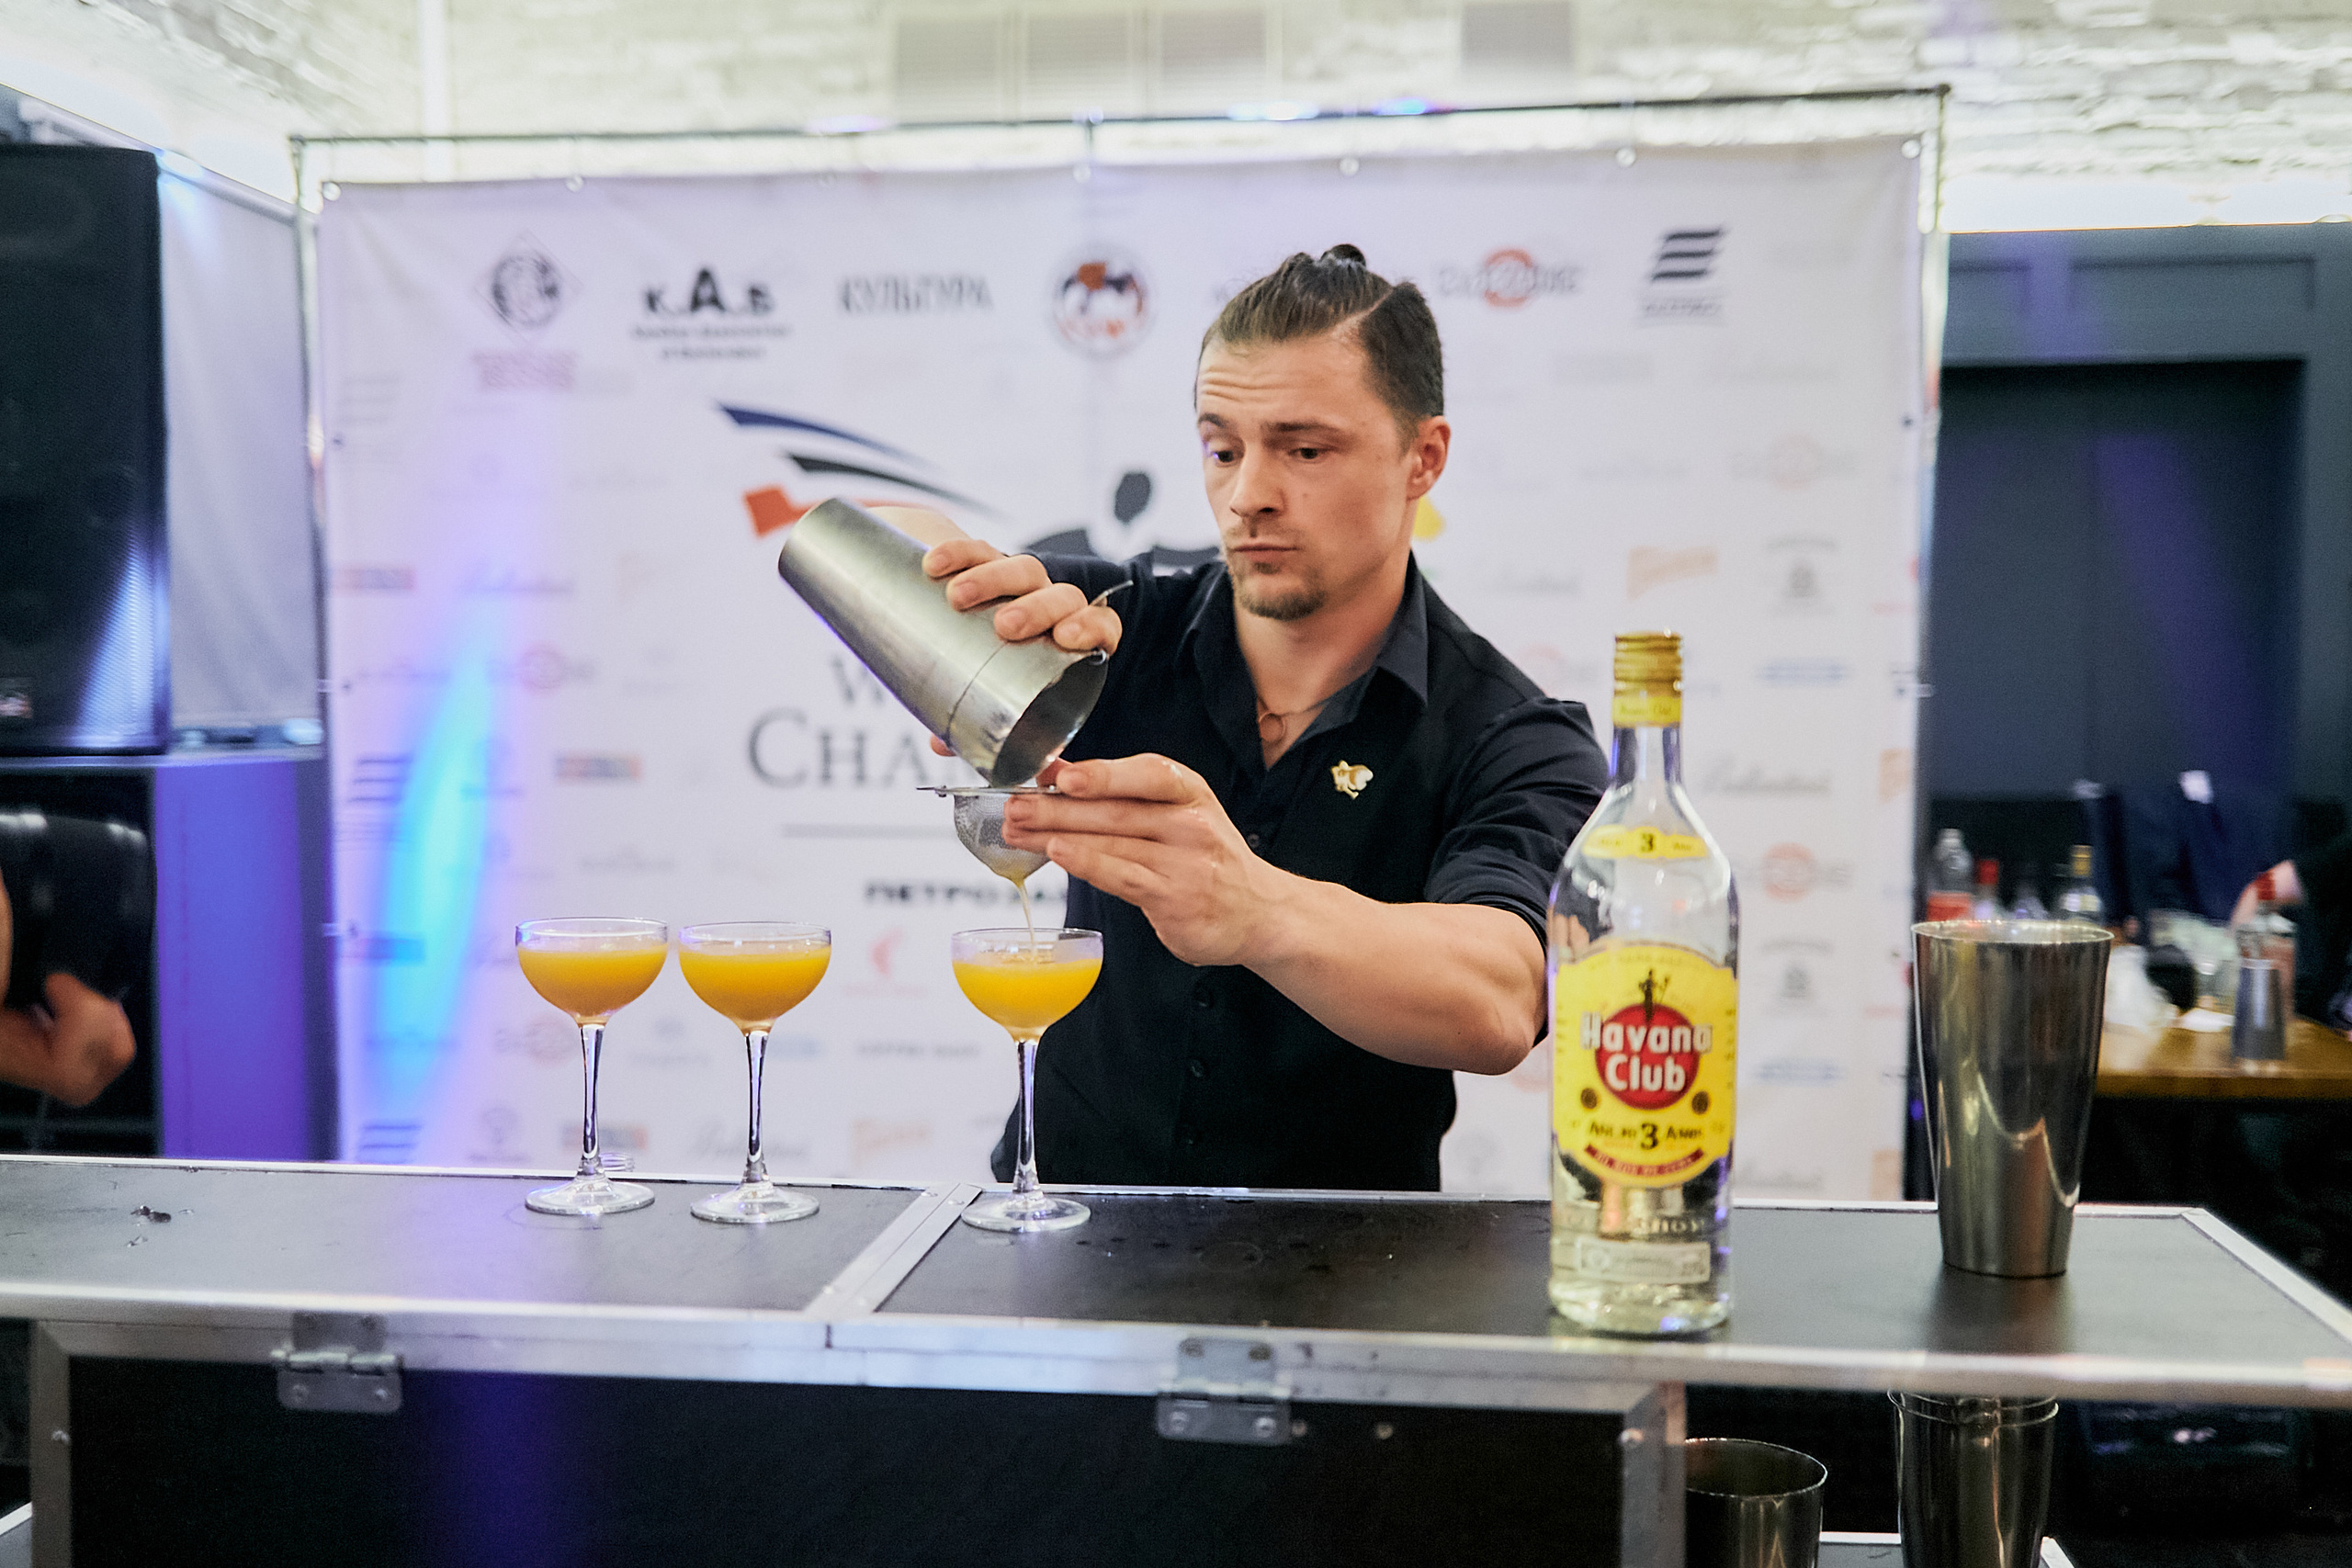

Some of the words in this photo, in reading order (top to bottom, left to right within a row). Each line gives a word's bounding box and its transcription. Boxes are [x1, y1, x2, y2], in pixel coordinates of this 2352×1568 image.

[748, 706, 976, 790] CHA
[1640, 833, 1655, 853] 3
[1580, 1011, 1713, 1055] Havana
[1605, 1054, 1686, 1092] Club
[1640, 1122, 1659, 1150] 3
